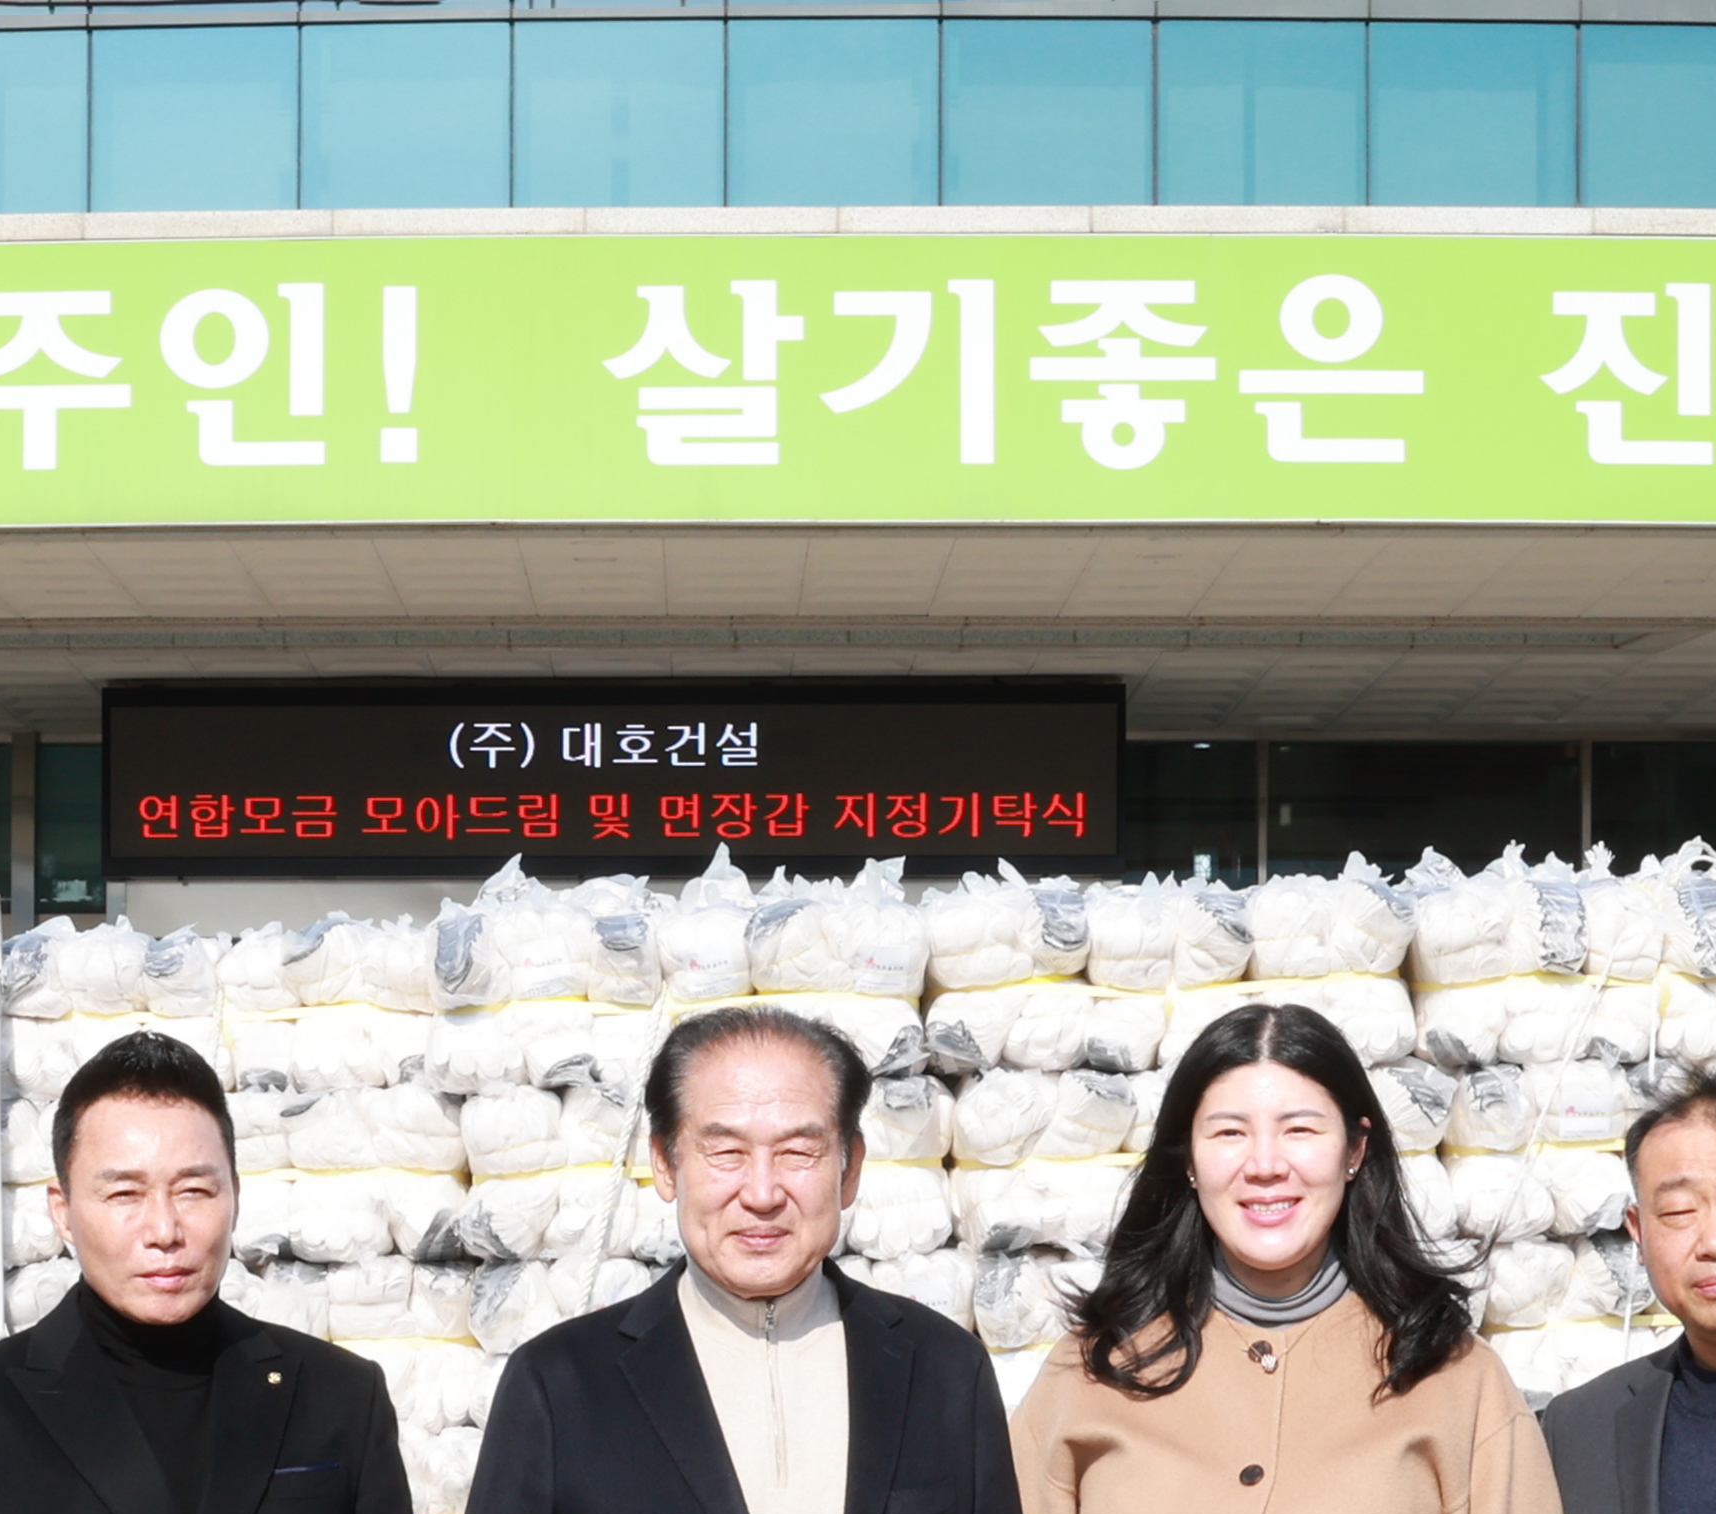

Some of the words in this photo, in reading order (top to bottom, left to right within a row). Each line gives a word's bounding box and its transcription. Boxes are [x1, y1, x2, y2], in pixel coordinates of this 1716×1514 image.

[601, 273, 1426, 471] 살기좋은
[449, 722, 536, 769] (주)
[562, 722, 758, 769] 대호건설
[138, 794, 338, 839] 연합모금
[361, 793, 560, 840] 모아드림
[588, 793, 631, 840] 및
[659, 792, 810, 840] 면장갑
[834, 791, 1086, 839] 지정기탁식
